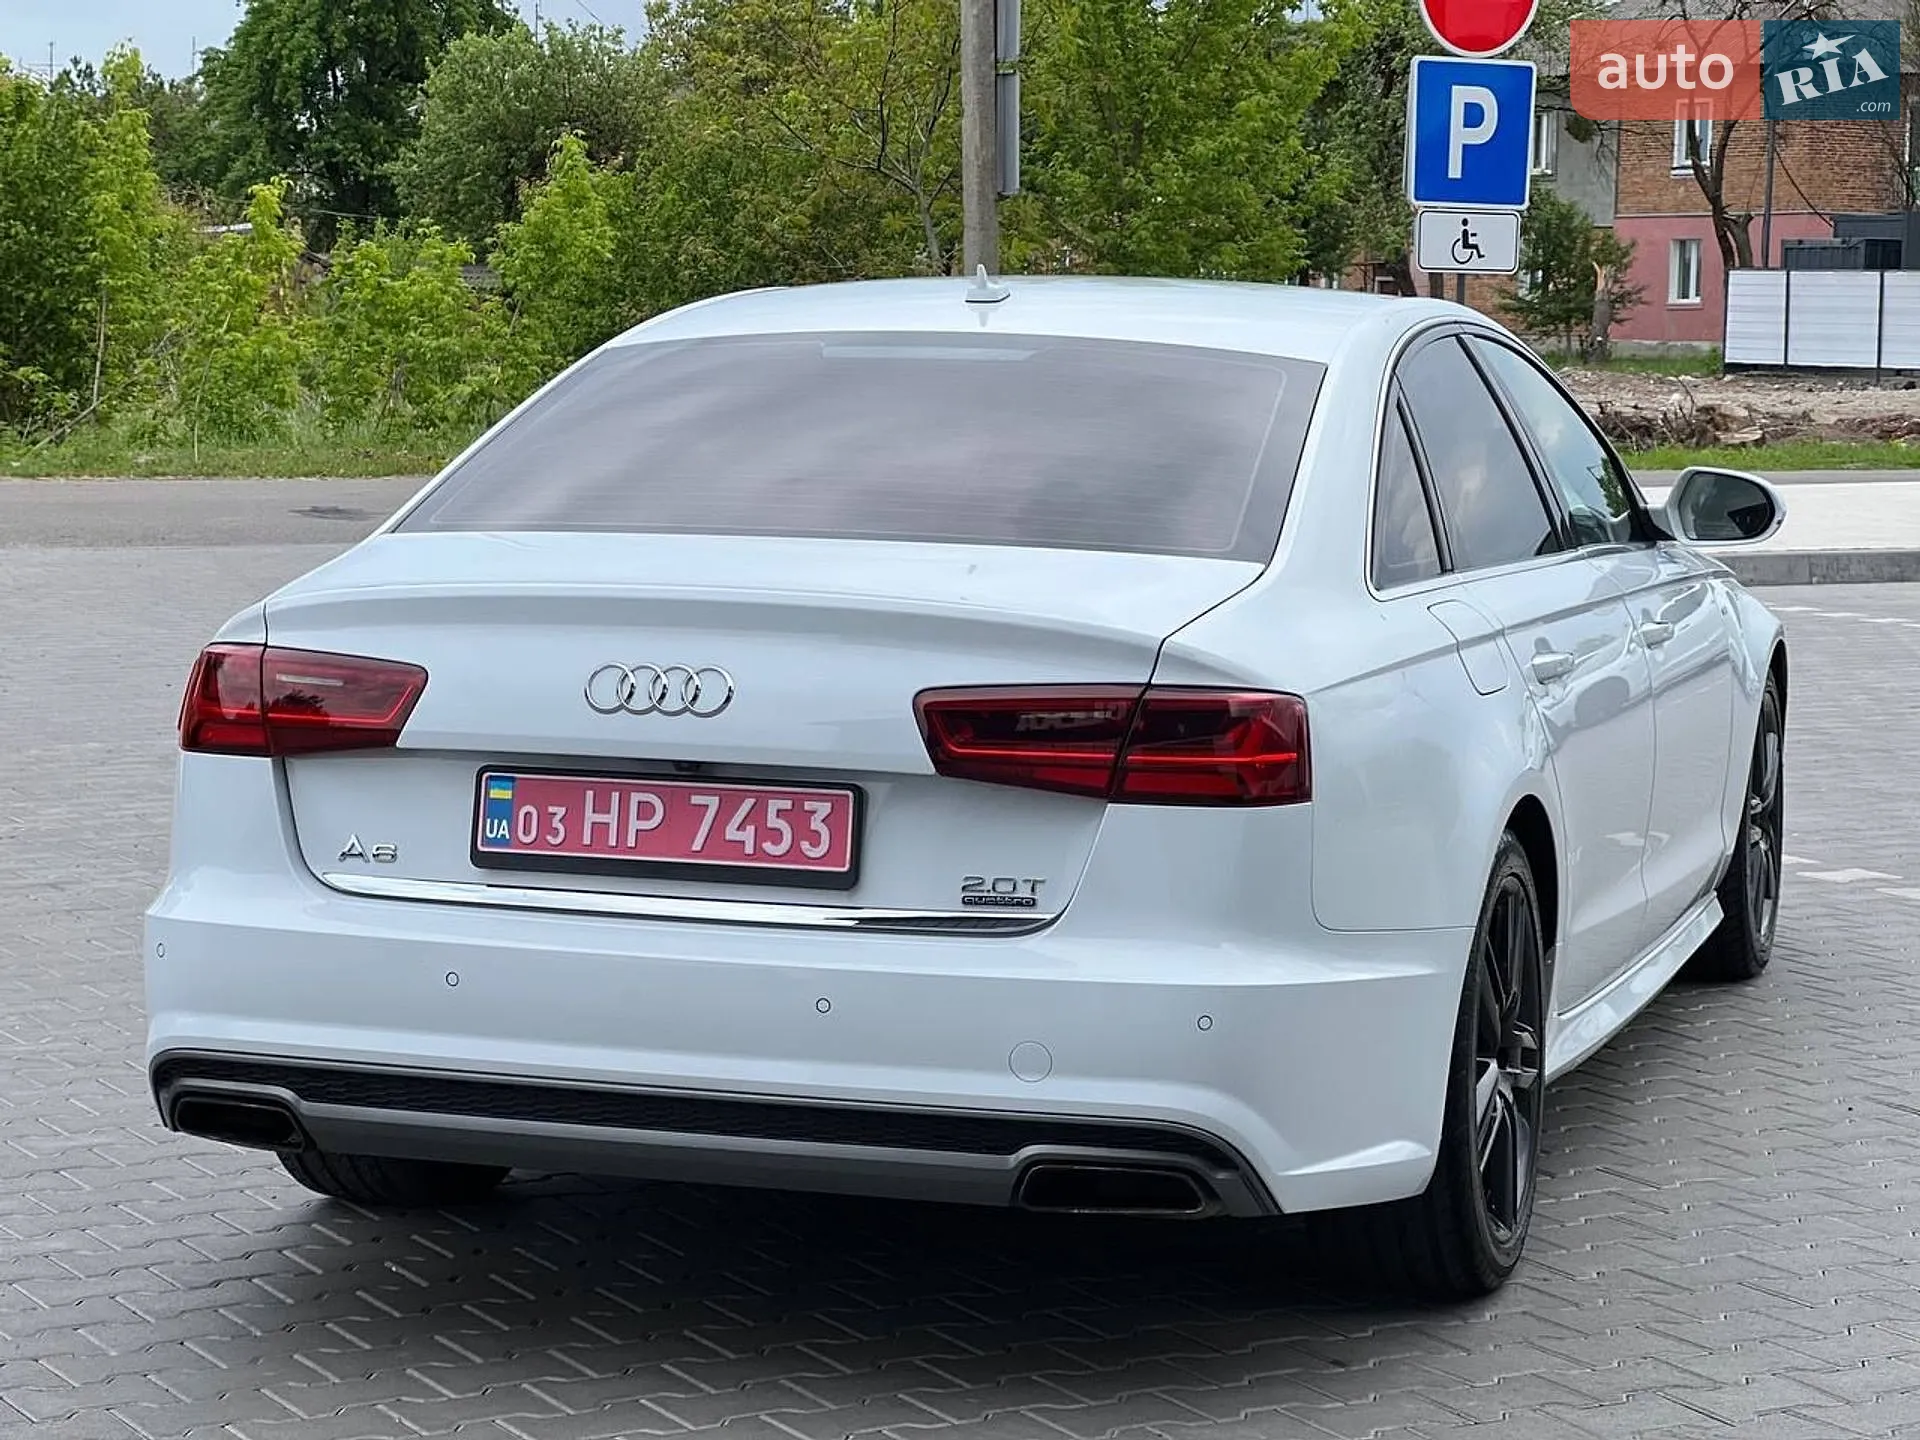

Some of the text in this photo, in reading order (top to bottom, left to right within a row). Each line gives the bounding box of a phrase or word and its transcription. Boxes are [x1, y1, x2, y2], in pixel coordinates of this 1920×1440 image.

[1447, 85, 1499, 179] P
[337, 833, 398, 863] A6
[486, 818, 510, 841] UA
[516, 790, 833, 859] 03 HP 7453
